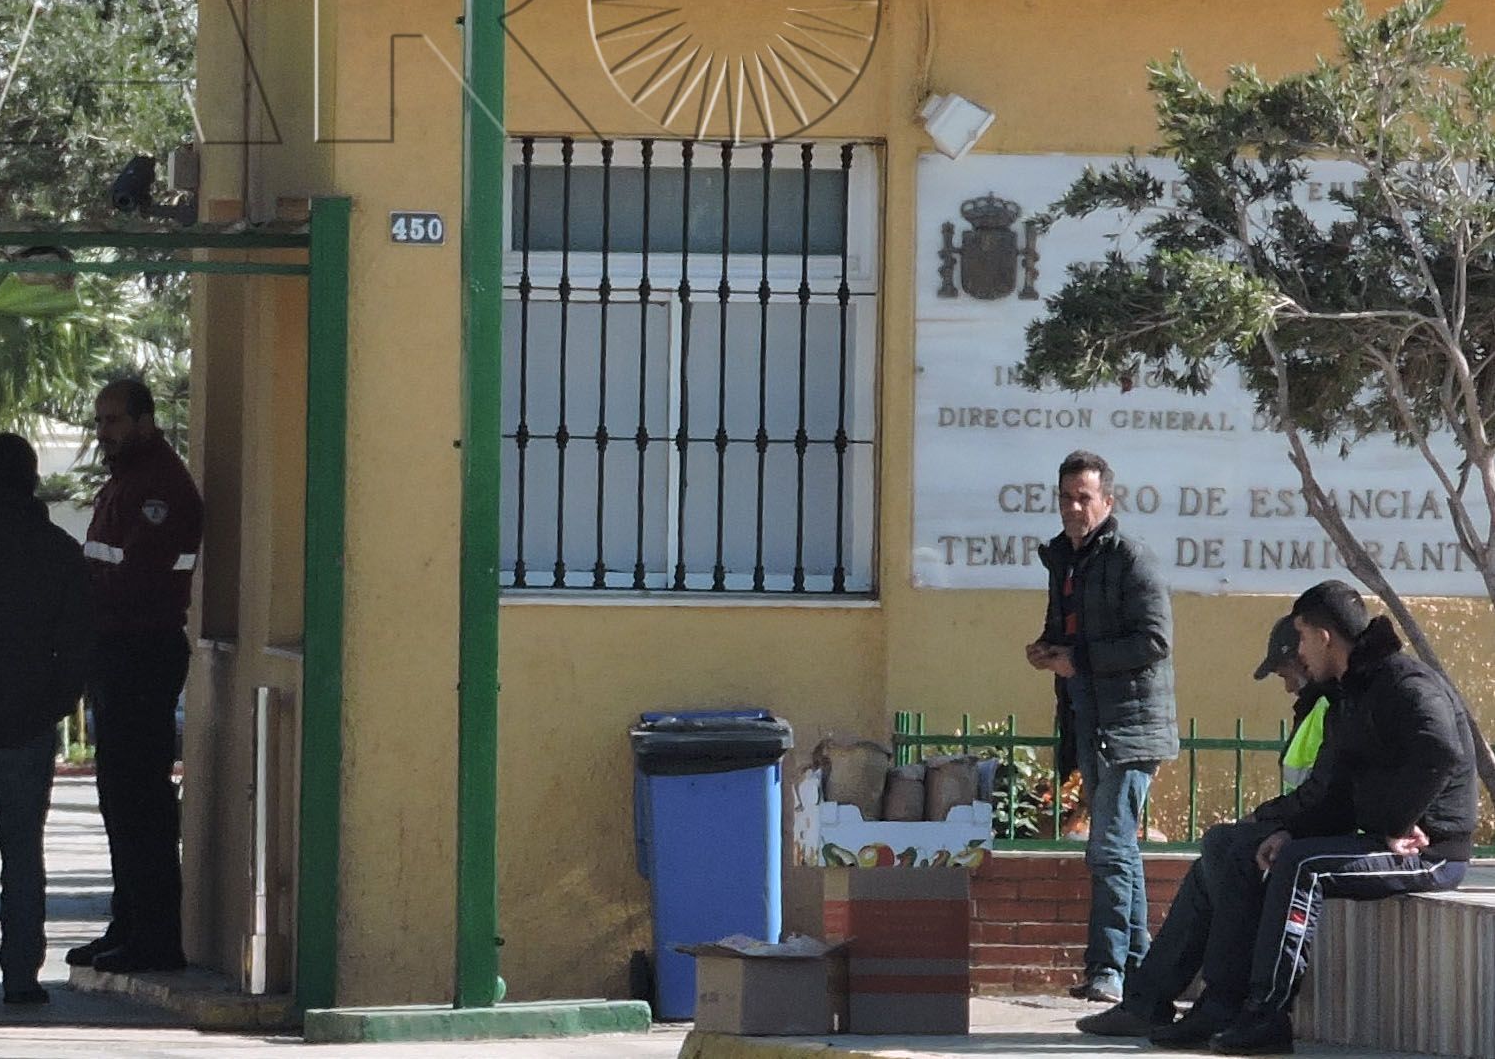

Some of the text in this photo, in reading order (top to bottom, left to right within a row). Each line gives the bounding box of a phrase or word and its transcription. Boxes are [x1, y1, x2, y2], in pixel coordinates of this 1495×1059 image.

[392, 217, 443, 240] 450
[937, 407, 1093, 430] DIRECCION
[1110, 409, 1235, 432] GENERAL
[998, 483, 1443, 519] CERO DE ESANCIA
[1175, 536, 1225, 569] DE
